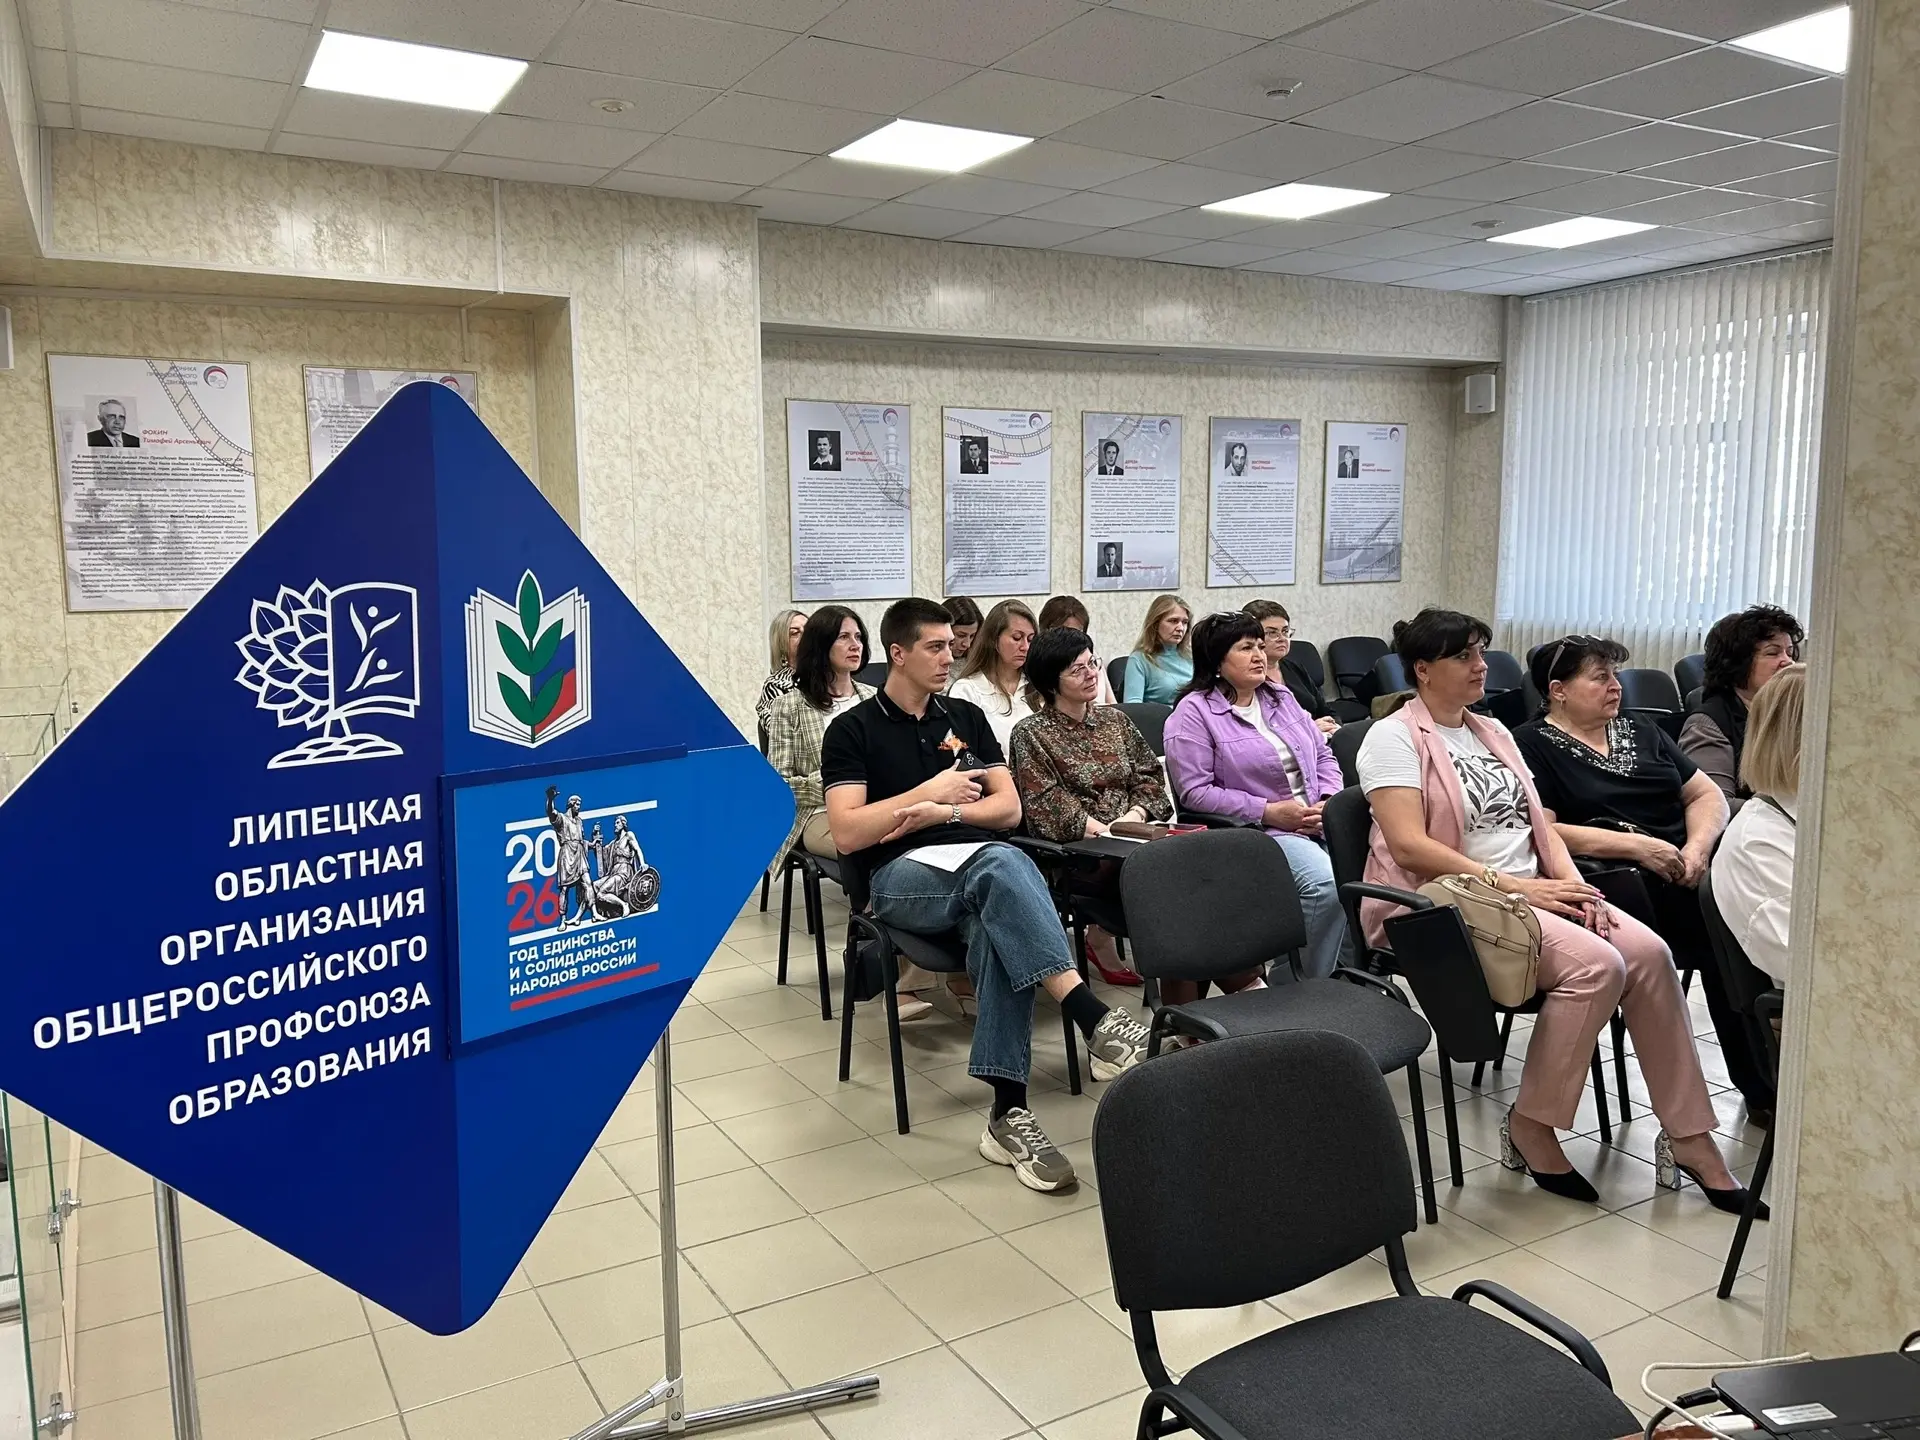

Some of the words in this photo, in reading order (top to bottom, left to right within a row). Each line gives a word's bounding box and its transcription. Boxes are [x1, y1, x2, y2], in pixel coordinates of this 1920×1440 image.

[143, 437, 173, 446] Тимофей
[229, 793, 422, 847] ЛИПЕЦКАЯ
[214, 841, 423, 902] ОБЛАСТНАЯ
[505, 829, 560, 883] 20
[160, 888, 425, 966] ОРГАНИЗАЦИЯ
[506, 877, 560, 932] 26
[509, 945, 539, 964] ГОД
[543, 928, 616, 957] ЕДИНСТВА
[509, 966, 520, 980] И
[525, 937, 637, 976] СОЛИДАРНОСТИ
[33, 935, 428, 1049] ОБЩЕРОССИЙСКОГО
[509, 969, 578, 997] НАРОДОВ
[582, 952, 637, 976] РОССИИ
[207, 982, 431, 1063] ПРОФСОЮЗА
[168, 1027, 431, 1125] ОБРАЗОВАНИЯ
